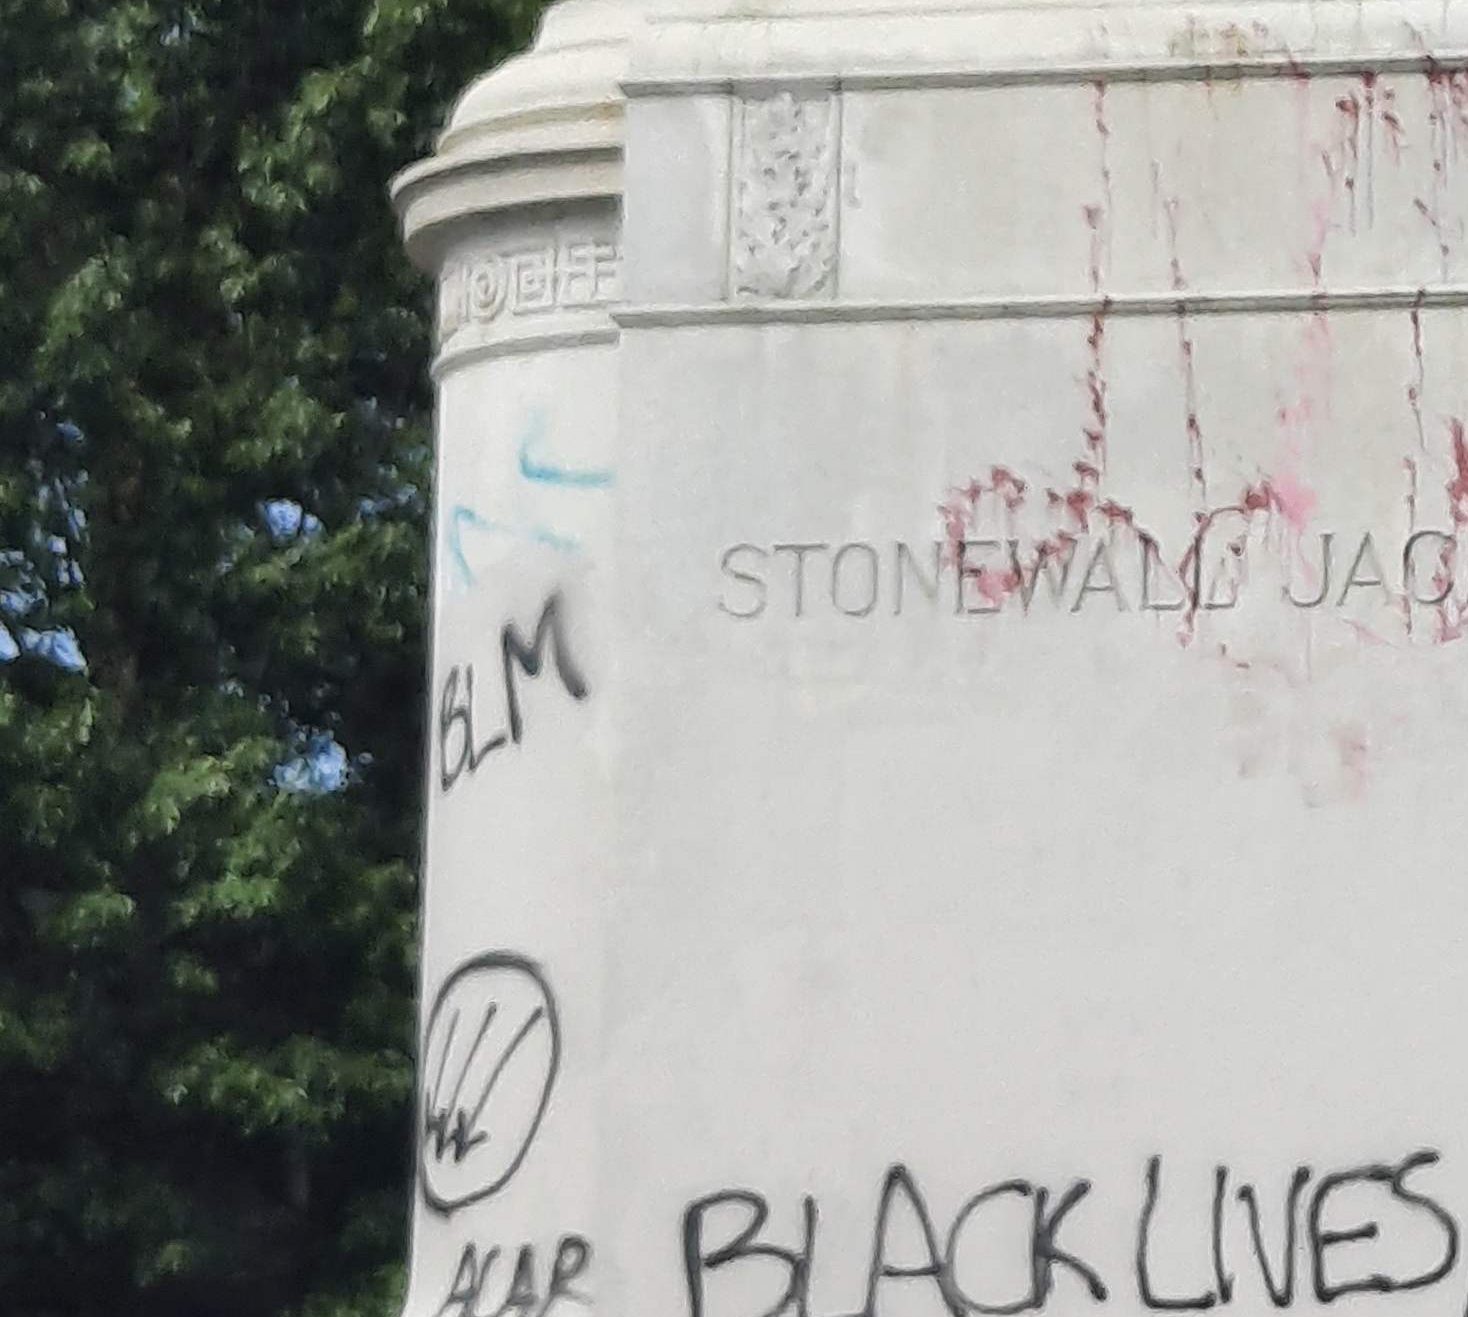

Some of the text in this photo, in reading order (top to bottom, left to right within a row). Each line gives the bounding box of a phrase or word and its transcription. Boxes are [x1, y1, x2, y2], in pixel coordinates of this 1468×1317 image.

[718, 540, 1240, 619] STONEWALL
[438, 589, 588, 791] BLM
[1135, 1147, 1461, 1309] LIVES
